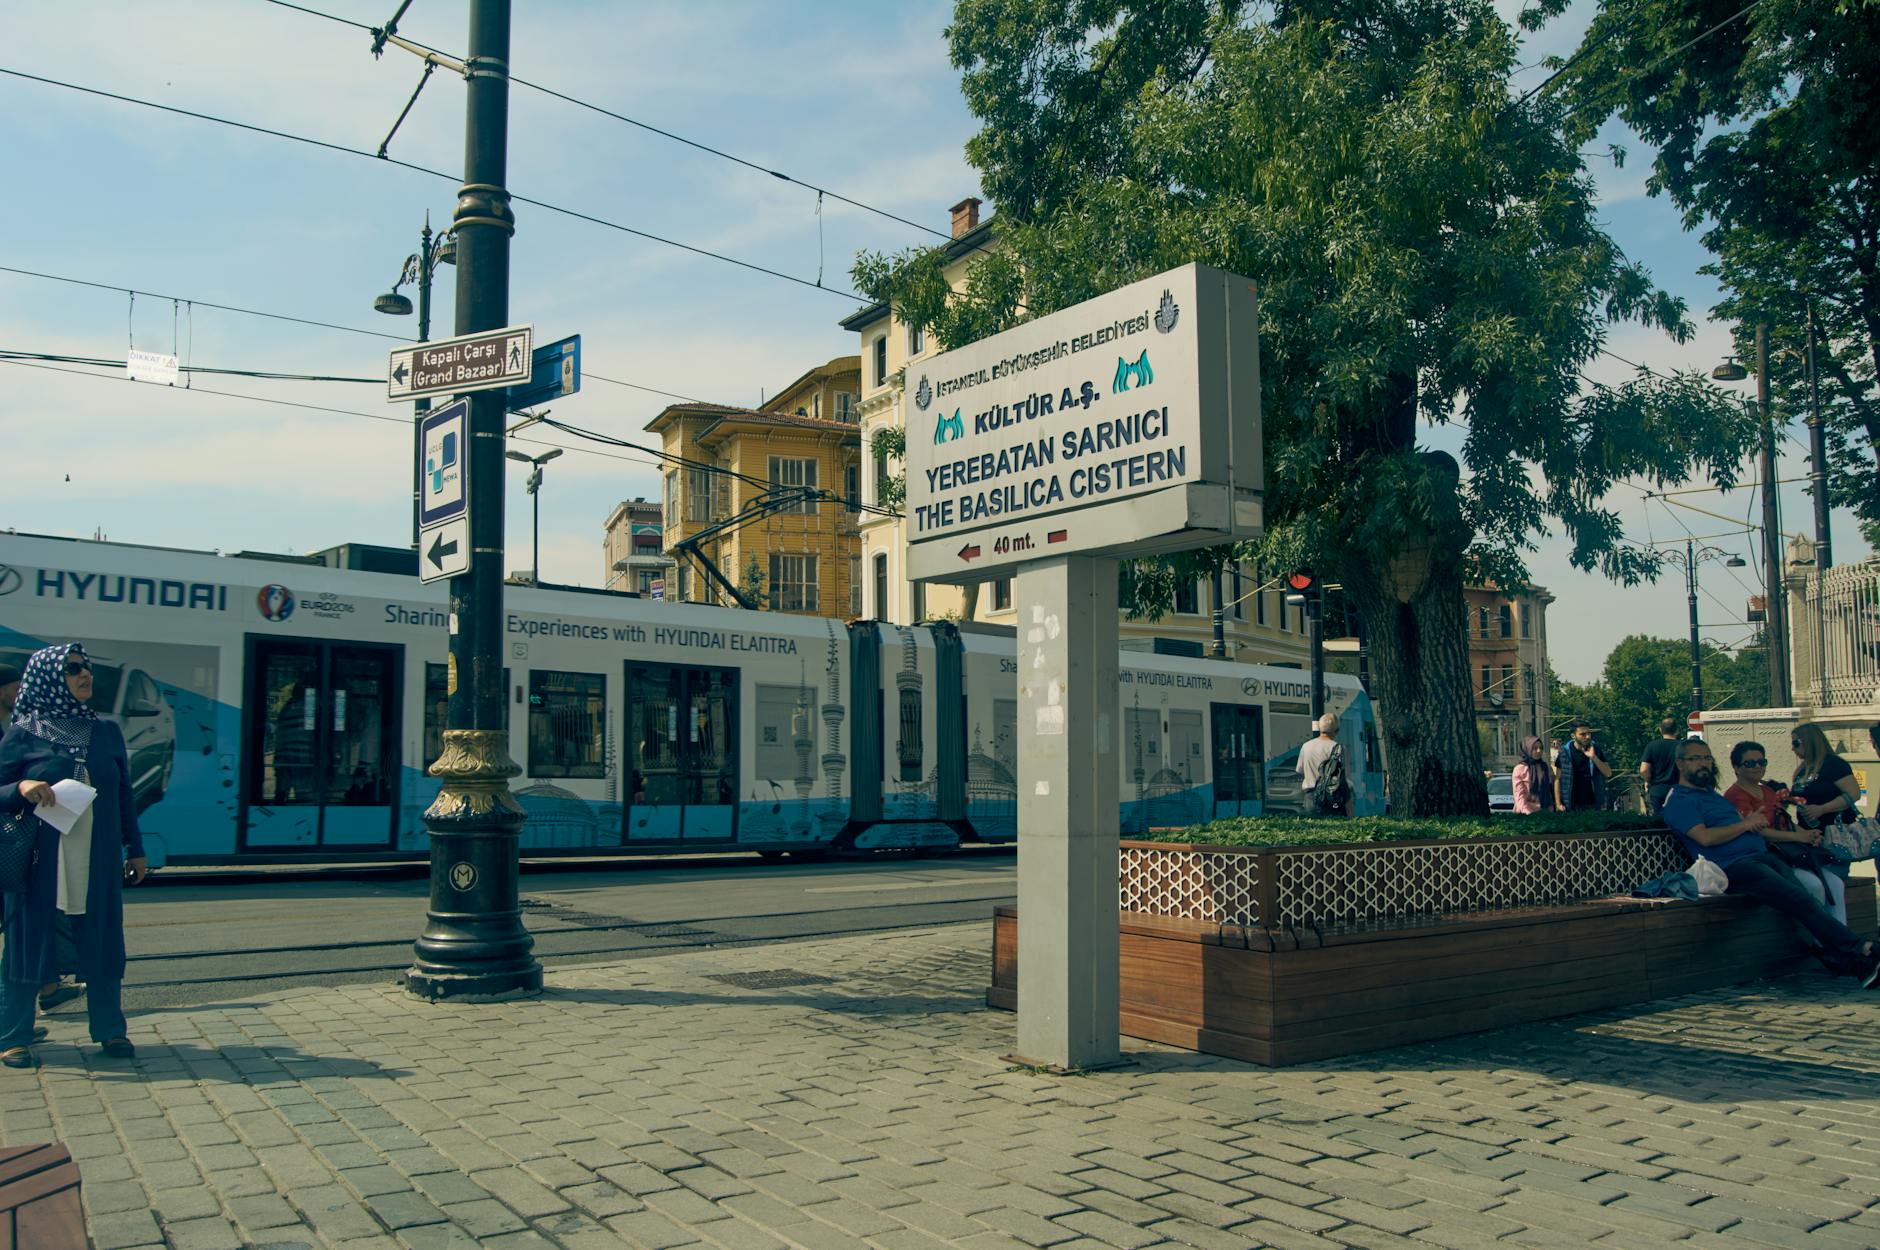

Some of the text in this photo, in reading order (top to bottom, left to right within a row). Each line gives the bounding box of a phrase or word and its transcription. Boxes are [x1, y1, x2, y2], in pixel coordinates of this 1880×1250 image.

[413, 358, 504, 388] (Grand Bazaar)
[422, 344, 496, 367] Kapalı Çarşı
[936, 309, 1149, 398] İSTANBUL BÜYÜKŞEHİR BELEDİYESİ
[974, 381, 1100, 435] KÜLTÜR A.Ş.
[926, 406, 1168, 493] YEREBATAN SARNICI
[915, 446, 1186, 532] THE BASILICA CISTERN
[994, 532, 1035, 554] 40 mt.
[36, 568, 227, 611] HYUNDAI
[507, 614, 608, 642] Experiences
[613, 626, 646, 643] with
[655, 628, 726, 650] HYUNDAI
[730, 634, 798, 656] ELANTRA
[1137, 671, 1174, 688] HYUNDAI
[1176, 674, 1213, 691] ELANTRA
[1264, 680, 1310, 698] HYUNDA
